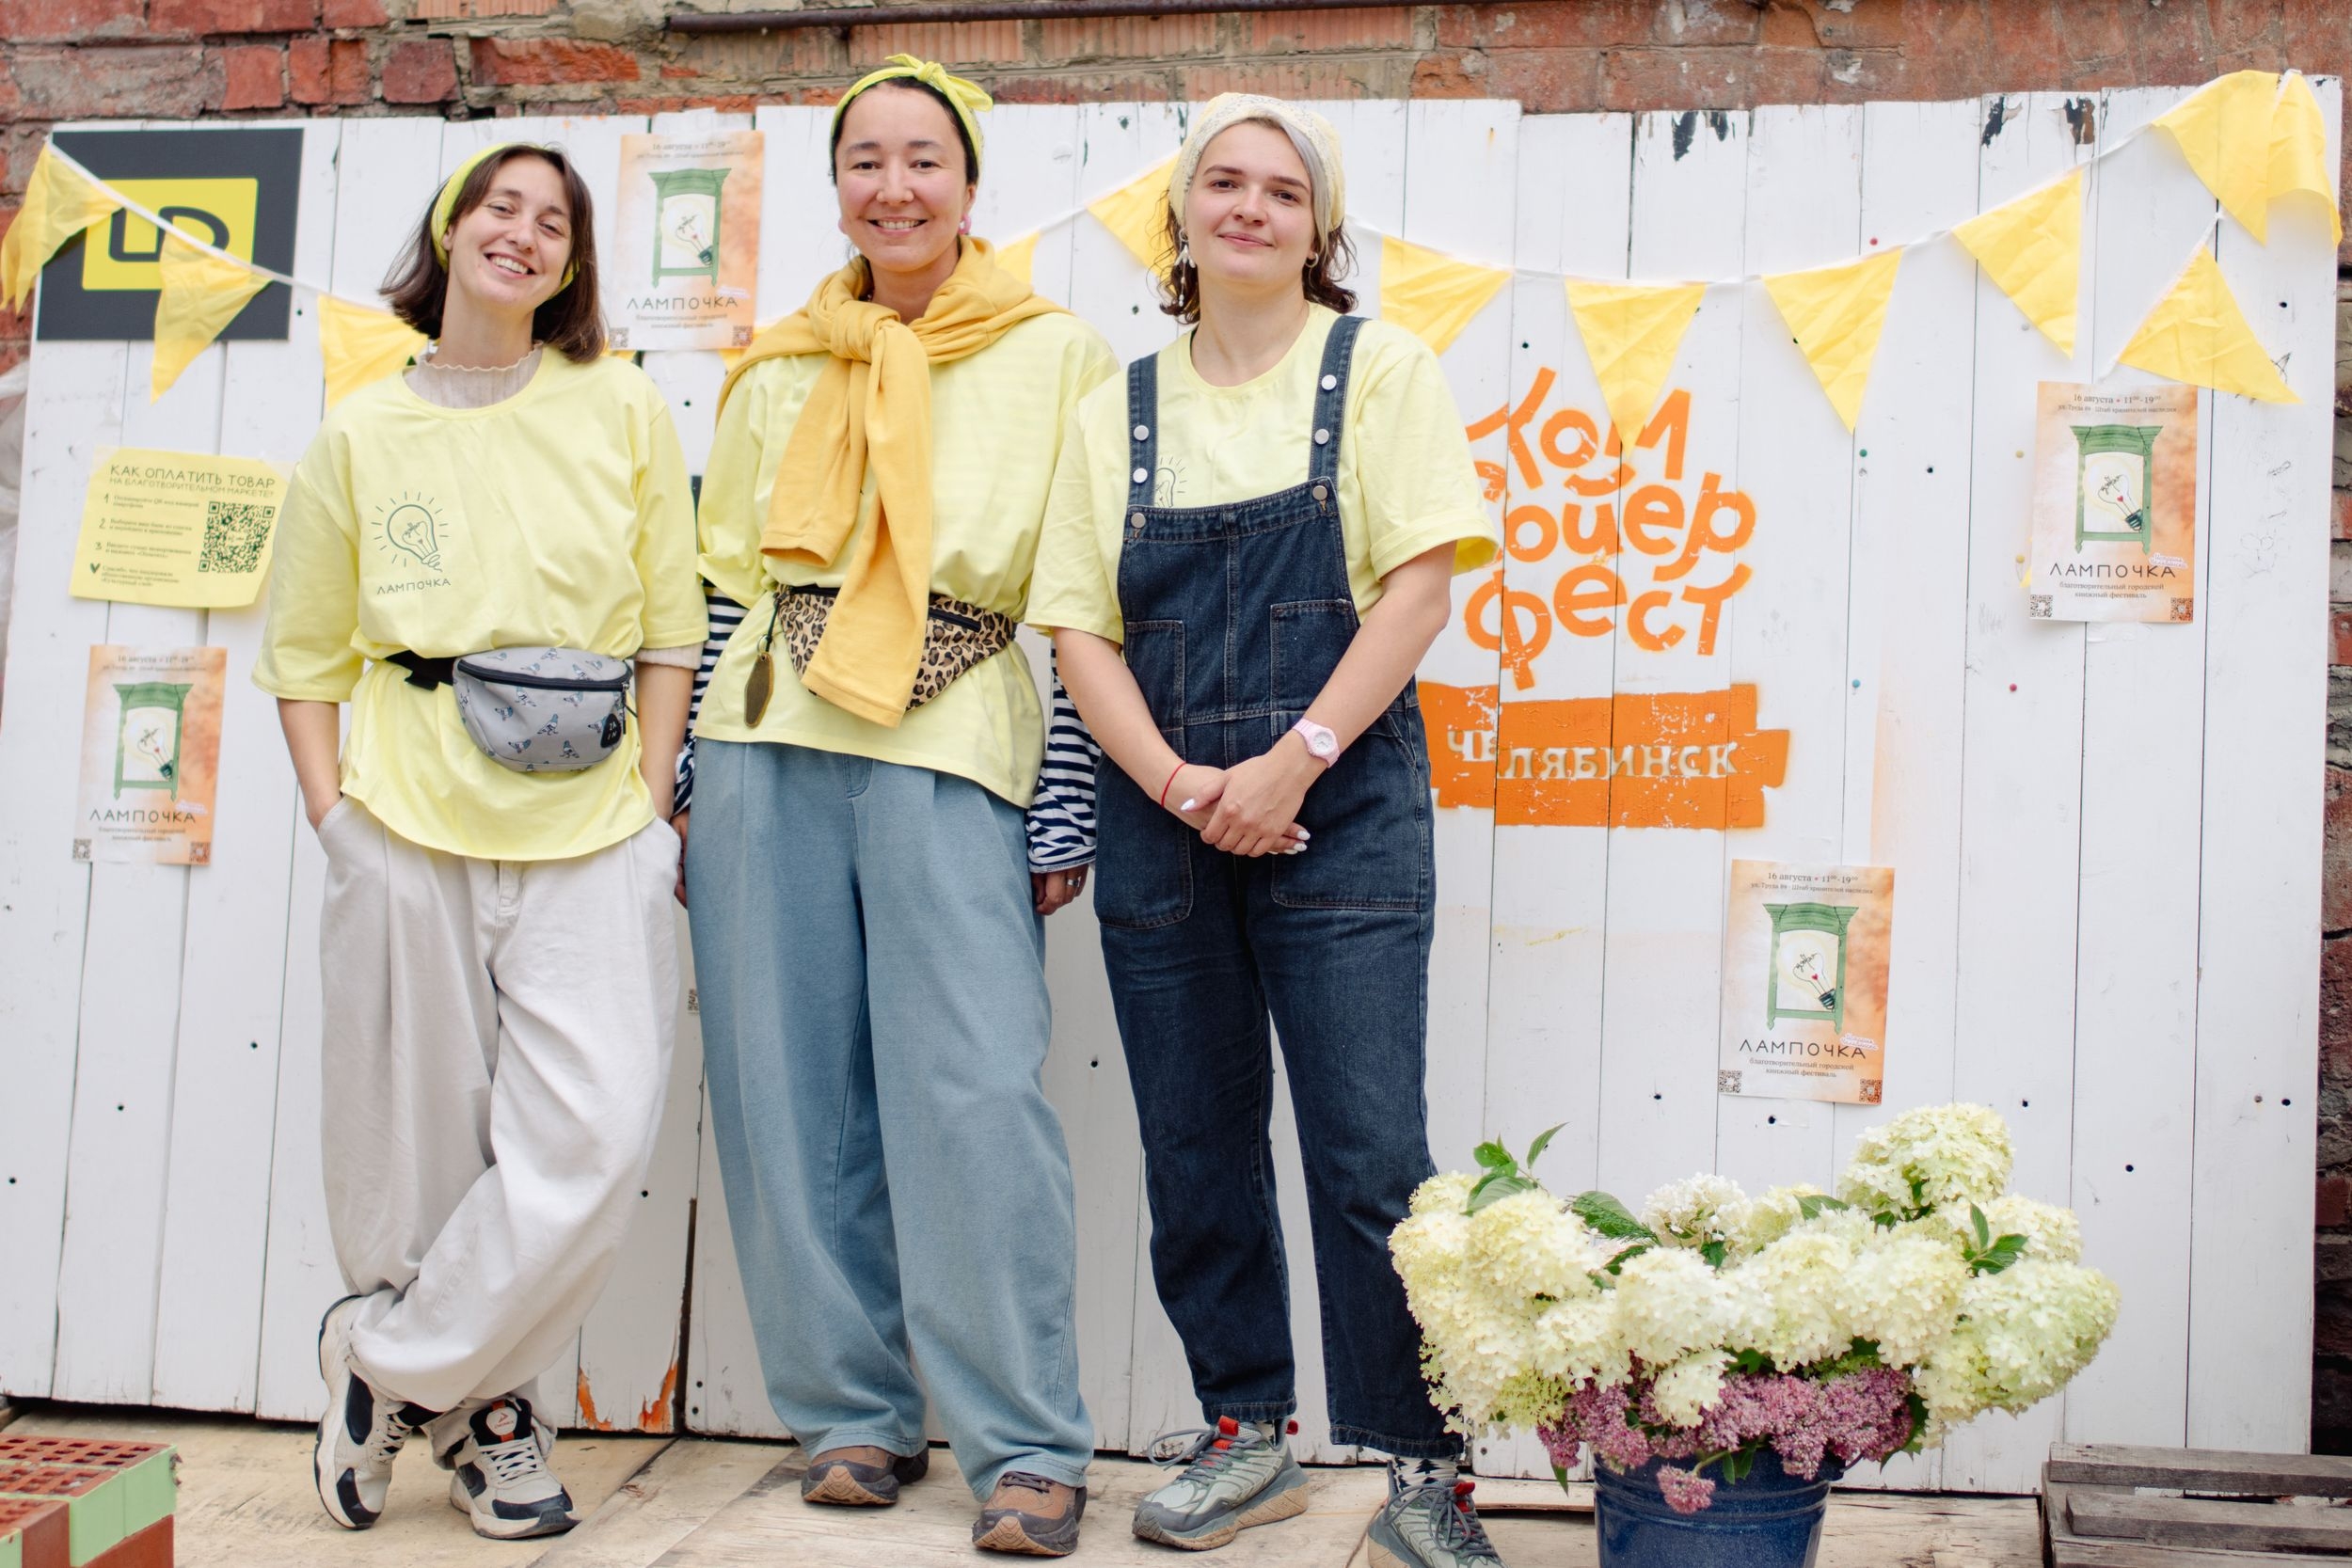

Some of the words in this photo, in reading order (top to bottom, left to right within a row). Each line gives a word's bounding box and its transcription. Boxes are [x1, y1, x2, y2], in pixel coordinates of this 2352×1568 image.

[627, 296, 739, 310] ЛАМПОЧКА
[2074, 393, 2082, 402] 16
[2083, 394, 2114, 404] августа
[110, 465, 140, 478] КАК
[145, 467, 222, 485] ОПЛАТИТЬ
[228, 474, 276, 489] ТОВАР
[103, 493, 109, 504] 1
[99, 517, 105, 530] 2
[2049, 562, 2176, 578] ЛАМПОЧКА
[377, 578, 452, 594] ЛАМПОЧКА
[1447, 729, 1738, 780] ЧЕЛЯБИНСК
[89, 809, 196, 823] ЛАМПОЧКА
[1768, 872, 1777, 880] 16
[1779, 874, 1812, 882] августа
[1740, 1038, 1866, 1059] ЛАМПОЧКА
[1749, 1057, 1818, 1069] благотворительный
[1819, 1062, 1854, 1070] городской
[1801, 1069, 1837, 1078] фестиваль
